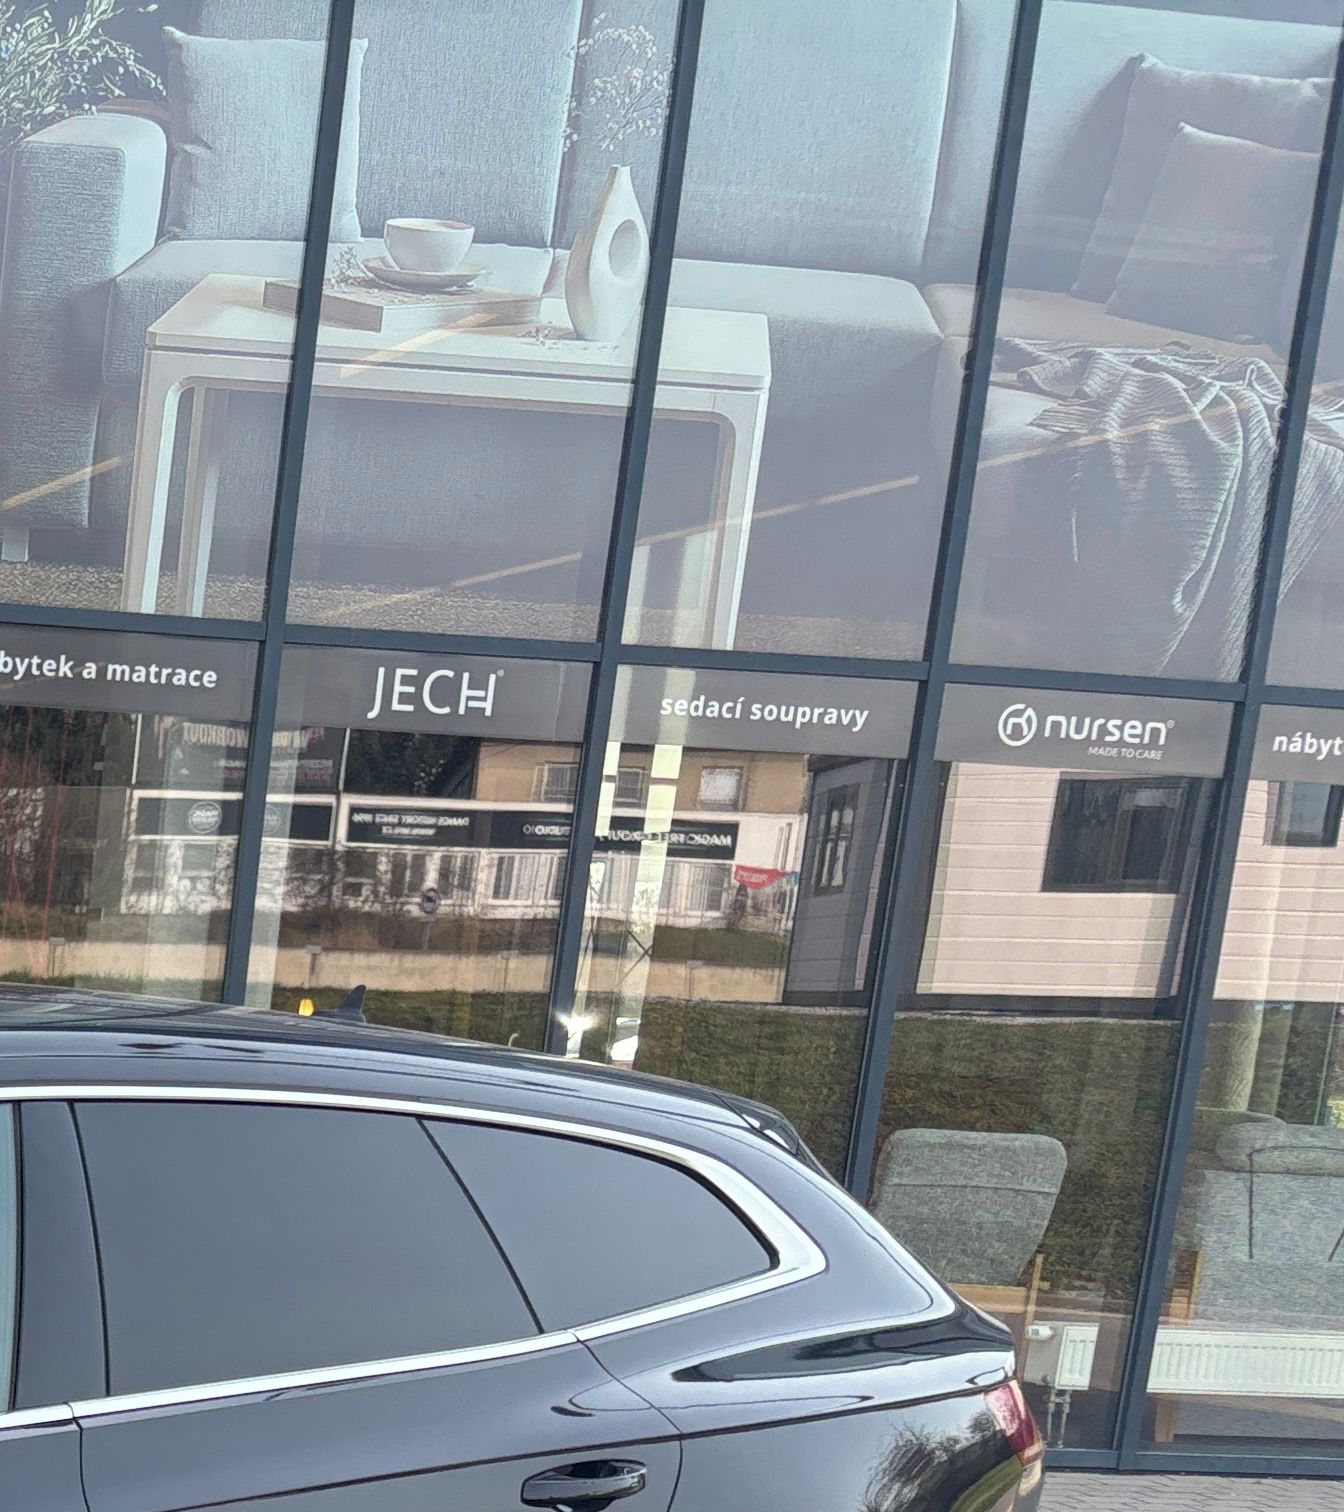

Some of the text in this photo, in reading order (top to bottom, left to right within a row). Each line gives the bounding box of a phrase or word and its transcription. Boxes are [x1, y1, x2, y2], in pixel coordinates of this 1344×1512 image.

[81, 662, 98, 680] a
[106, 662, 218, 688] matrace
[367, 665, 499, 719] JECH
[660, 694, 870, 732] sedací soupravy
[1043, 715, 1168, 746] nursen
[1087, 746, 1164, 760] MADE TO CARE
